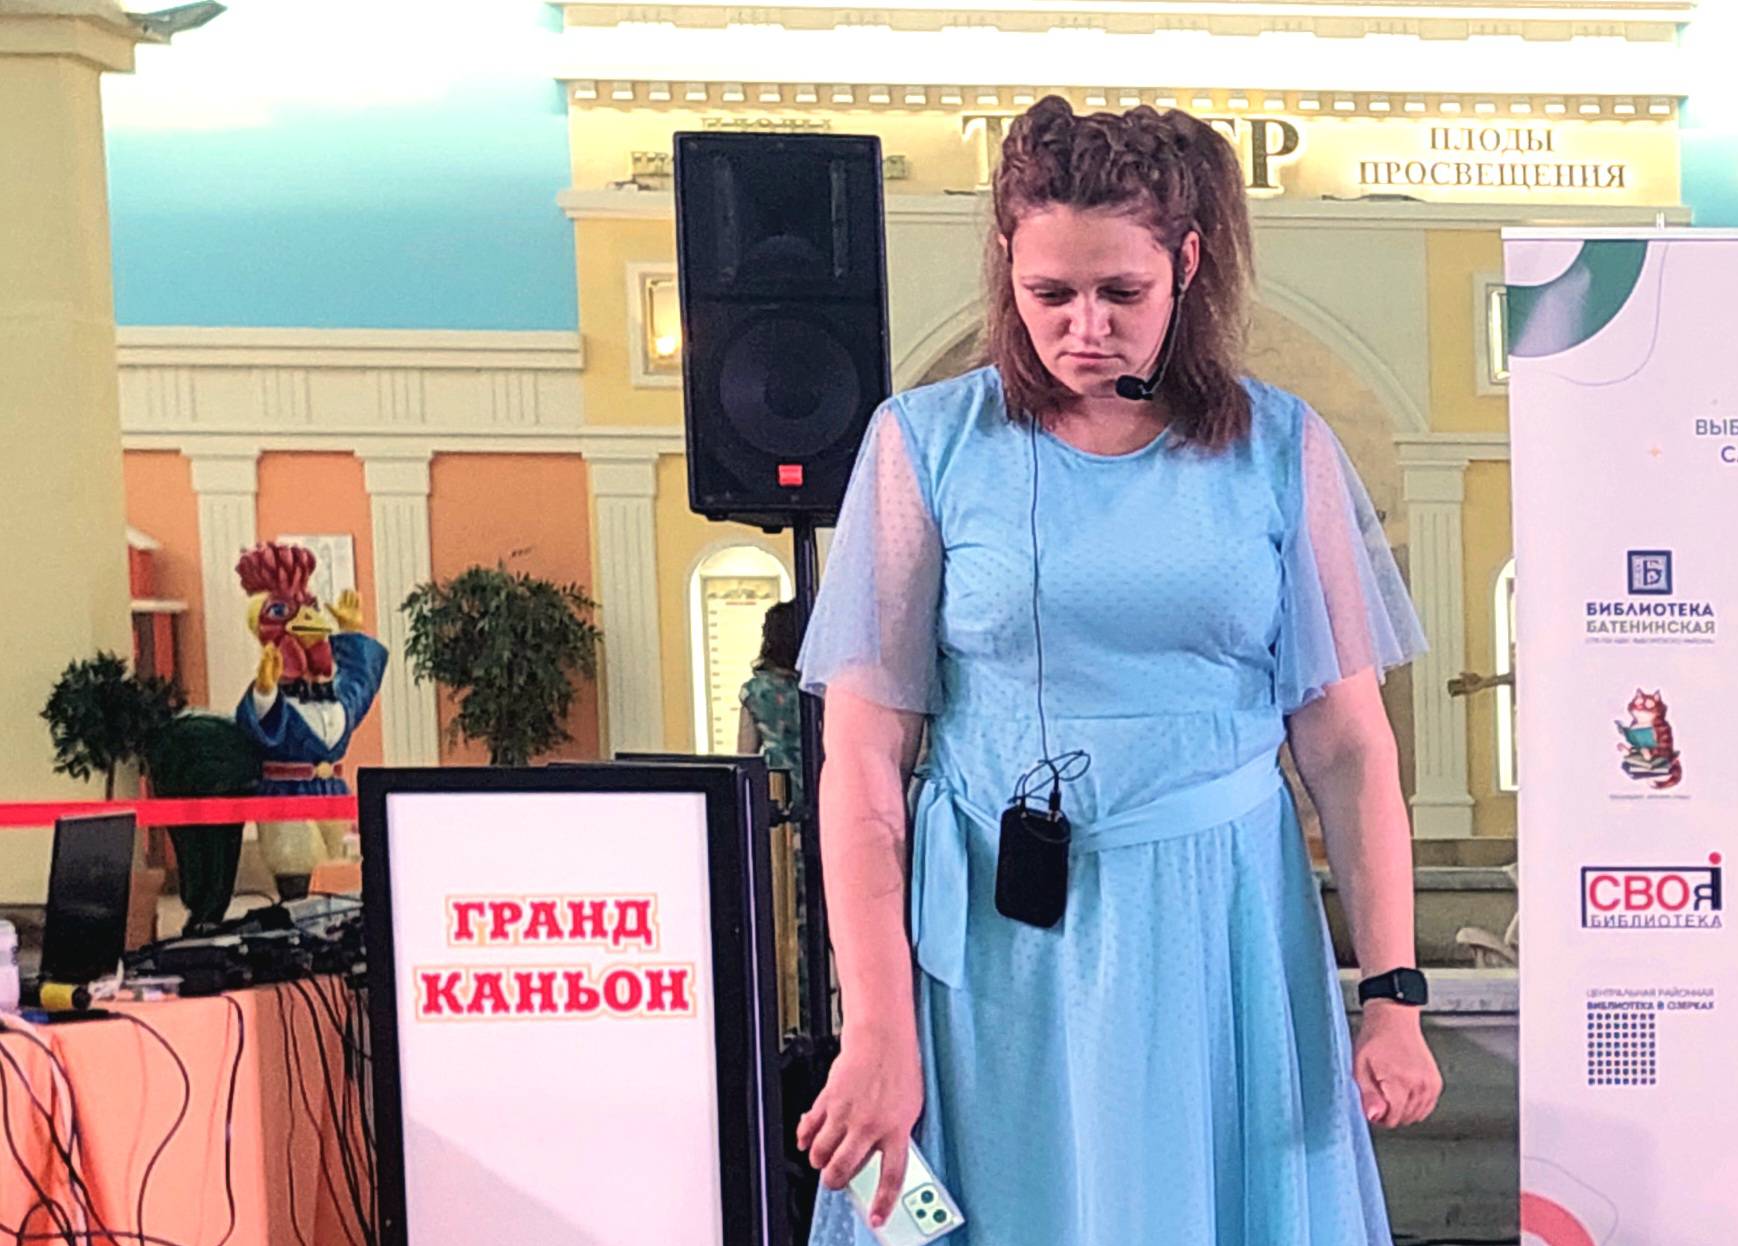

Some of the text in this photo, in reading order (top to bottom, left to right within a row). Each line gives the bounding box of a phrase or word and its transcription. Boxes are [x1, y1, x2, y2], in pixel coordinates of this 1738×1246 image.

[1430, 127, 1555, 153] ПЛОДЫ
[1358, 160, 1627, 190] ПРОСВЕЩЕНИЯ
[1586, 602, 1714, 617] БИБЛИОТЕКА
[1586, 620, 1716, 634] БАТЕНИНСКАЯ
[453, 900, 653, 946] ГРАНД
[1590, 914, 1722, 928] БИБЛИОТЕКА
[421, 969, 690, 1014] КАНЬОН
